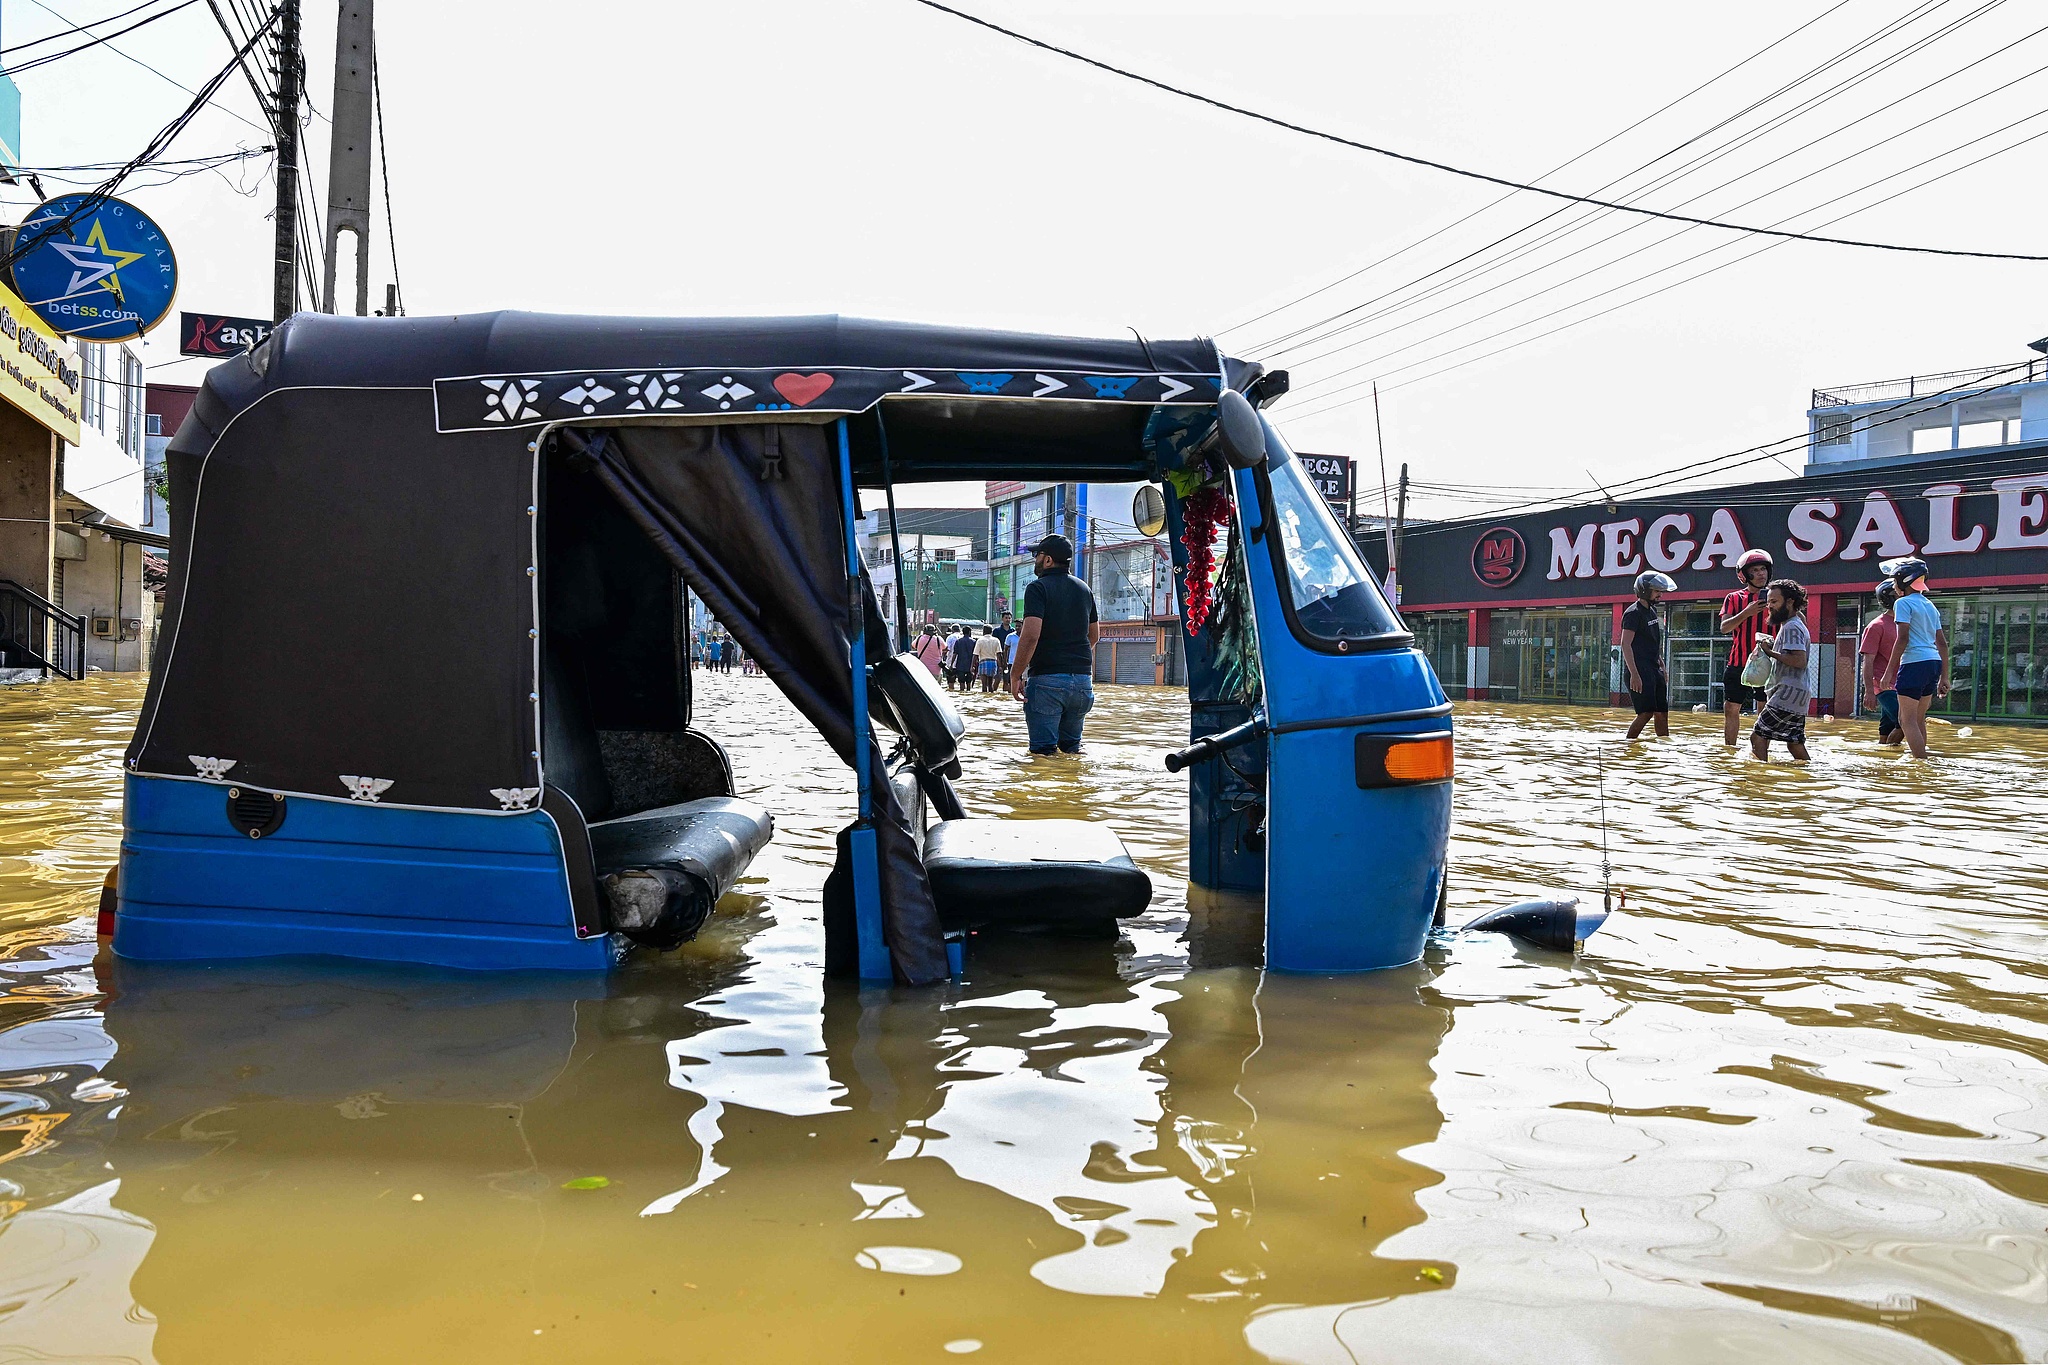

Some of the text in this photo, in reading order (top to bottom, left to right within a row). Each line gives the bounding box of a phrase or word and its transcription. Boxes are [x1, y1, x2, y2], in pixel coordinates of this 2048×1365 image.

[136, 220, 171, 273] STAR
[48, 302, 138, 320] betss.com
[1785, 473, 2048, 563] SALE
[1547, 508, 1750, 581] MEGA
[1502, 637, 1533, 645] NEW YEAR
[1507, 629, 1528, 637] HAPPY
